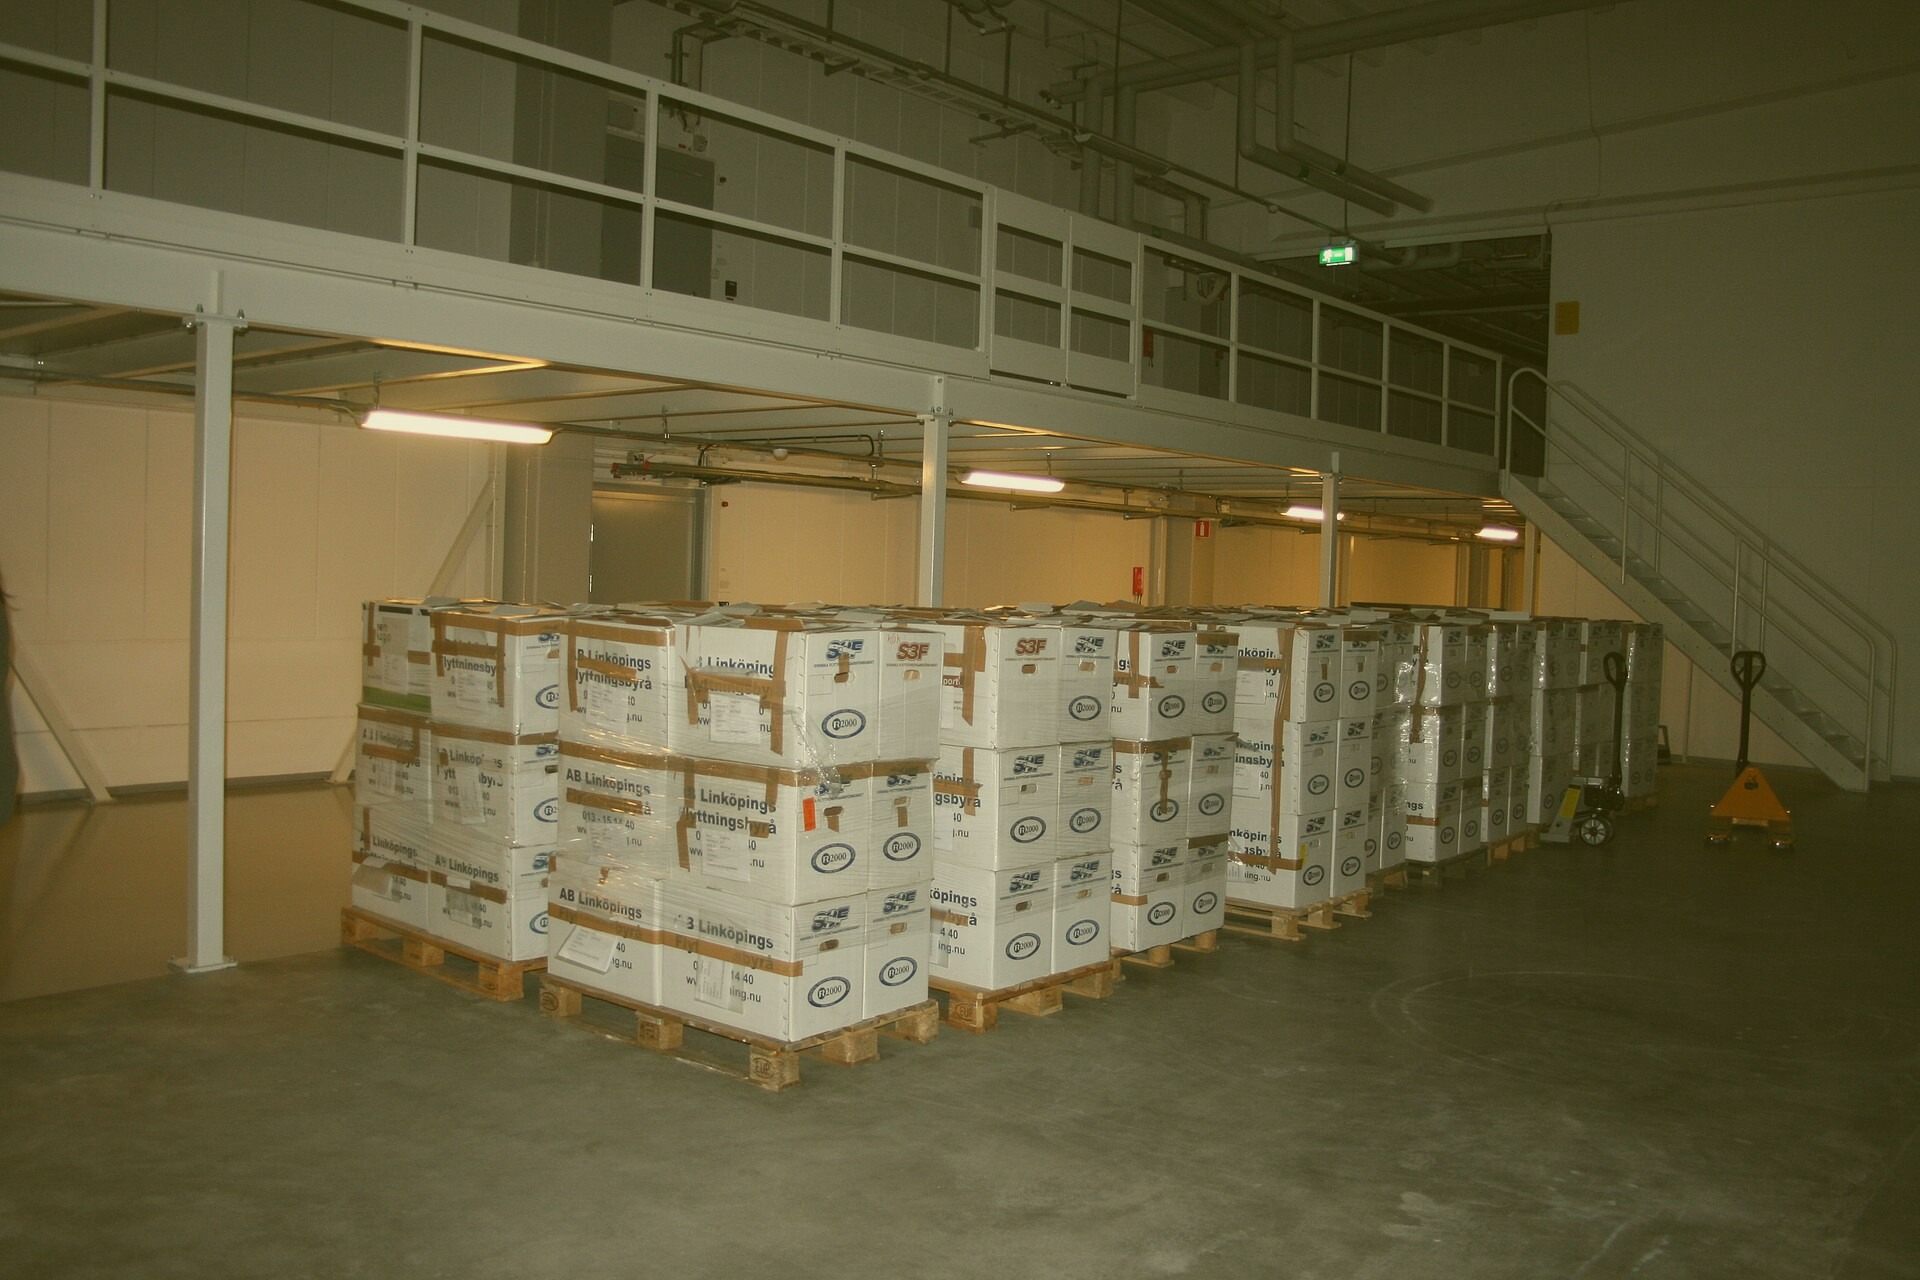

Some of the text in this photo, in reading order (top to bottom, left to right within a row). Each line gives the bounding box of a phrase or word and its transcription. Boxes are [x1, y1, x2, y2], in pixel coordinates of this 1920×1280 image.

[896, 642, 931, 661] S3F
[1015, 637, 1048, 656] S3F
[443, 656, 497, 677] lyttningsby
[707, 656, 775, 678] Linköping
[575, 667, 652, 691] lyttningsbyrå
[566, 768, 651, 797] AB Linköpings
[700, 788, 777, 815] Linköpings
[625, 820, 635, 831] 40
[449, 859, 499, 883] Linköpings
[559, 887, 642, 920] AB Linköpings
[930, 888, 977, 908] köpings
[699, 919, 774, 950] Linköpings
[948, 928, 958, 940] 40
[616, 942, 626, 953] 40
[743, 973, 754, 985] 40
